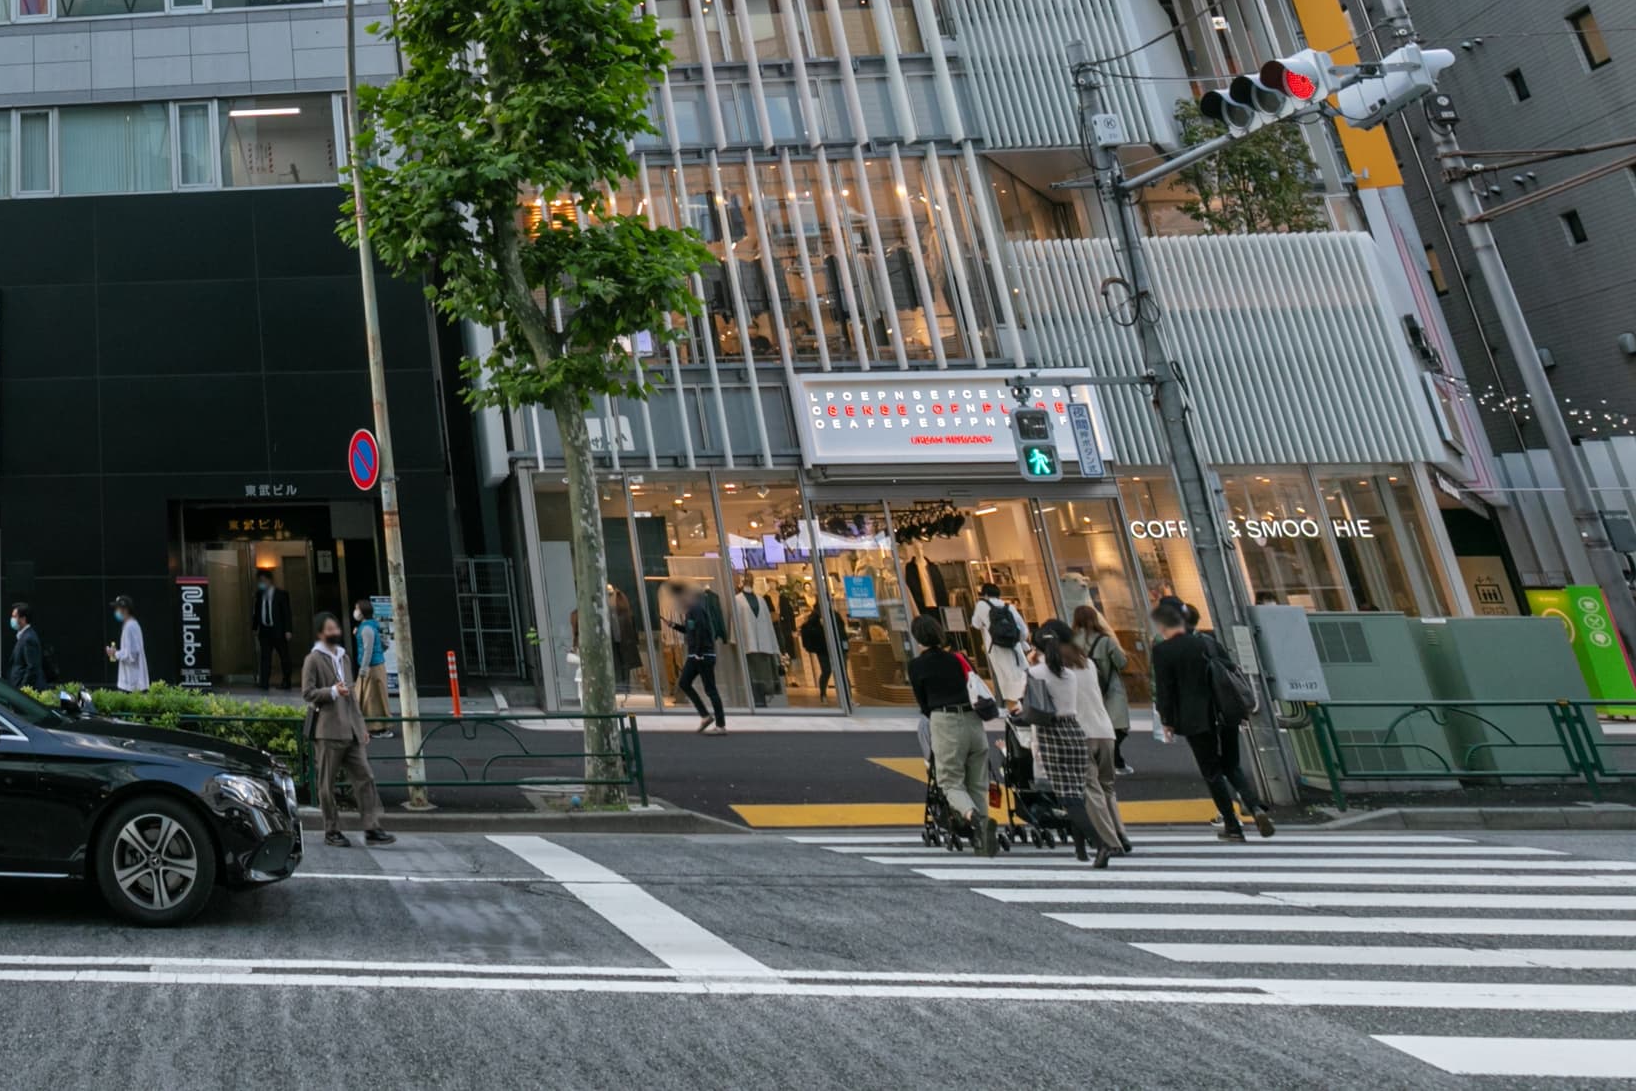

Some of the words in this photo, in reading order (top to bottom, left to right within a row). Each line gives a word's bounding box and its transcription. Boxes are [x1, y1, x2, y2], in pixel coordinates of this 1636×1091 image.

[245, 484, 297, 497] 東武ビル
[1130, 520, 1188, 539] COFF
[1246, 519, 1374, 538] SMOOHIE
[181, 585, 204, 621] Nail
[183, 625, 202, 666] Labo
